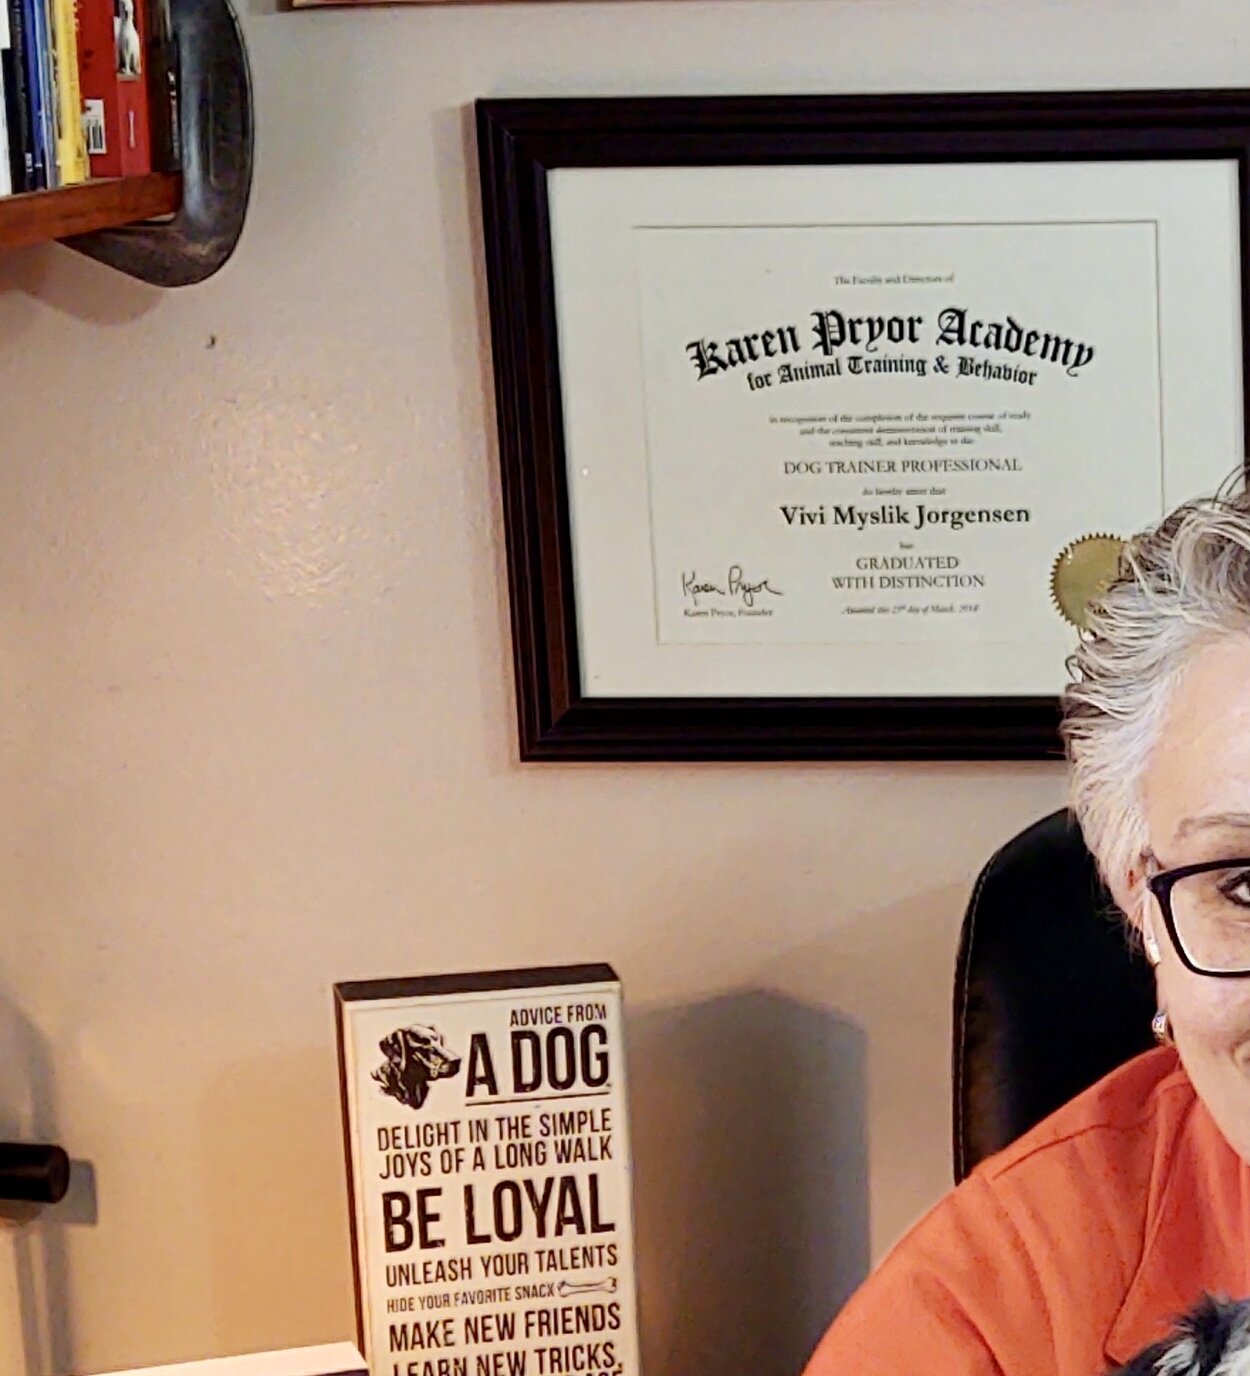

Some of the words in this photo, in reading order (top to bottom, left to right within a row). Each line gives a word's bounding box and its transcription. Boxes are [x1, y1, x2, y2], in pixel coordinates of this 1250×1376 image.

[686, 325, 800, 381] Karen
[810, 309, 923, 356] Pryor
[936, 307, 1094, 377] Academy
[747, 372, 773, 391] for
[778, 358, 842, 384] Animal
[847, 353, 926, 376] Training
[933, 355, 949, 374] &
[955, 356, 1037, 385] Behavior
[784, 460, 821, 474] DOG
[825, 460, 896, 474] TRAINER
[902, 458, 1022, 473] PROFESSIONAL
[780, 505, 825, 525] Vivi
[833, 505, 910, 530] Myslik
[915, 505, 1030, 530] Jorgensen
[831, 576, 874, 589] WITH
[879, 574, 985, 589] DISTINCTION
[856, 555, 959, 570] GRADUATED
[510, 1006, 562, 1026] ADVICE
[567, 1003, 607, 1023] FROM
[465, 1032, 499, 1097] A
[511, 1024, 609, 1094] DOG
[377, 1121, 461, 1151] DELIGHT
[469, 1119, 488, 1143] IN
[495, 1115, 532, 1141] THE
[539, 1108, 611, 1137] SIMPLE
[379, 1151, 432, 1180] JOYS
[441, 1147, 464, 1174] OF
[472, 1146, 485, 1171] A
[494, 1140, 547, 1169] LONG
[554, 1135, 612, 1164] WALK
[382, 1187, 445, 1253] BE
[463, 1173, 615, 1245] LOYAL
[386, 1256, 472, 1288] UNLEASH
[480, 1252, 529, 1278] YOUR
[535, 1243, 618, 1273] TALENTS
[387, 1297, 414, 1314] HIDE
[418, 1293, 451, 1310] YOUR
[454, 1287, 511, 1307] FAVORITE
[515, 1283, 555, 1301] SNACK
[389, 1318, 455, 1353] MAKE
[464, 1311, 516, 1344] NEW
[525, 1302, 621, 1339] FRIENDS
[534, 1342, 623, 1374] TRICKS,
